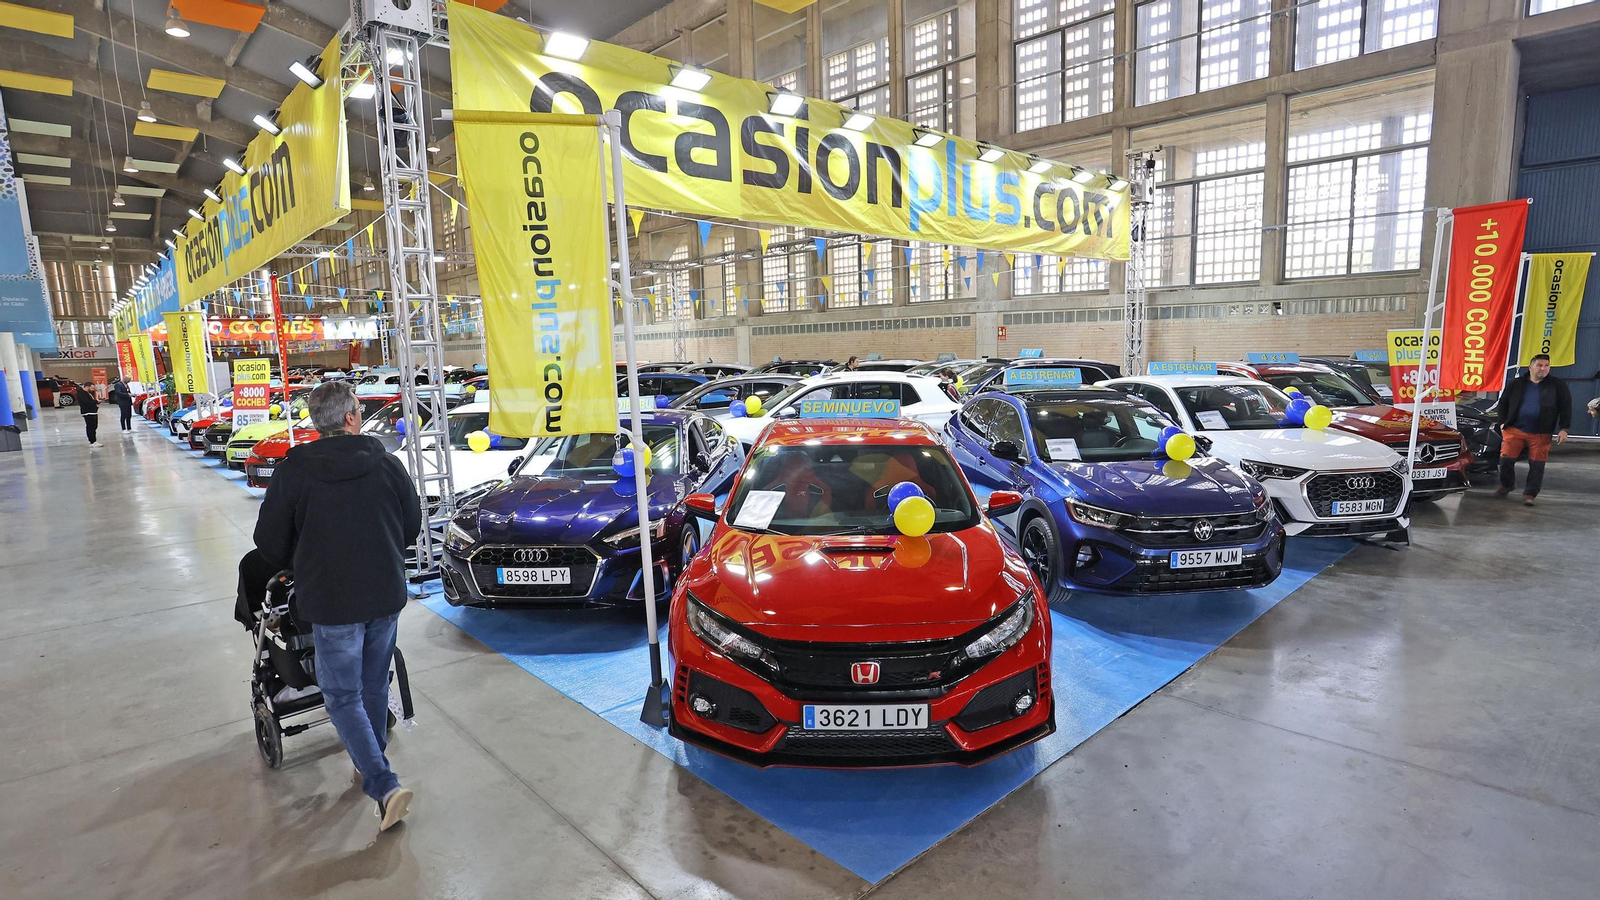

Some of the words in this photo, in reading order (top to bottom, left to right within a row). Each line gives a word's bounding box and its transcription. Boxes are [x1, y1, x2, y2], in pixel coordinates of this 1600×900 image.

[185, 141, 296, 284] ocasionplus.com
[1468, 218, 1500, 303] +10.000
[1541, 259, 1564, 354] ocasionplus.co
[229, 320, 314, 335] COCHES
[1394, 335, 1440, 347] ocasio
[1462, 308, 1489, 387] COCHES
[237, 363, 266, 372] ocasion
[1162, 363, 1213, 372] ESTRENAR
[236, 372, 266, 382] plus.com
[1010, 371, 1018, 380] A
[1020, 370, 1076, 380] ESTRENAR
[1402, 369, 1438, 385] +800
[239, 386, 265, 398] +8000
[1398, 385, 1452, 399] COHES
[236, 397, 267, 407] COCHES
[617, 398, 653, 409] DIEEL
[803, 401, 896, 413] SEMINUEVO
[236, 414, 249, 426] 85
[1412, 470, 1430, 479] 0331
[1433, 469, 1446, 477] JSV
[1339, 503, 1363, 513] 5583
[1365, 501, 1383, 511] MGN
[1180, 552, 1210, 565] 9557
[1215, 550, 1238, 563] MJM
[506, 570, 538, 582] 8598
[542, 569, 567, 581] LPY
[819, 709, 871, 727] 3621
[882, 707, 922, 727] LDY
